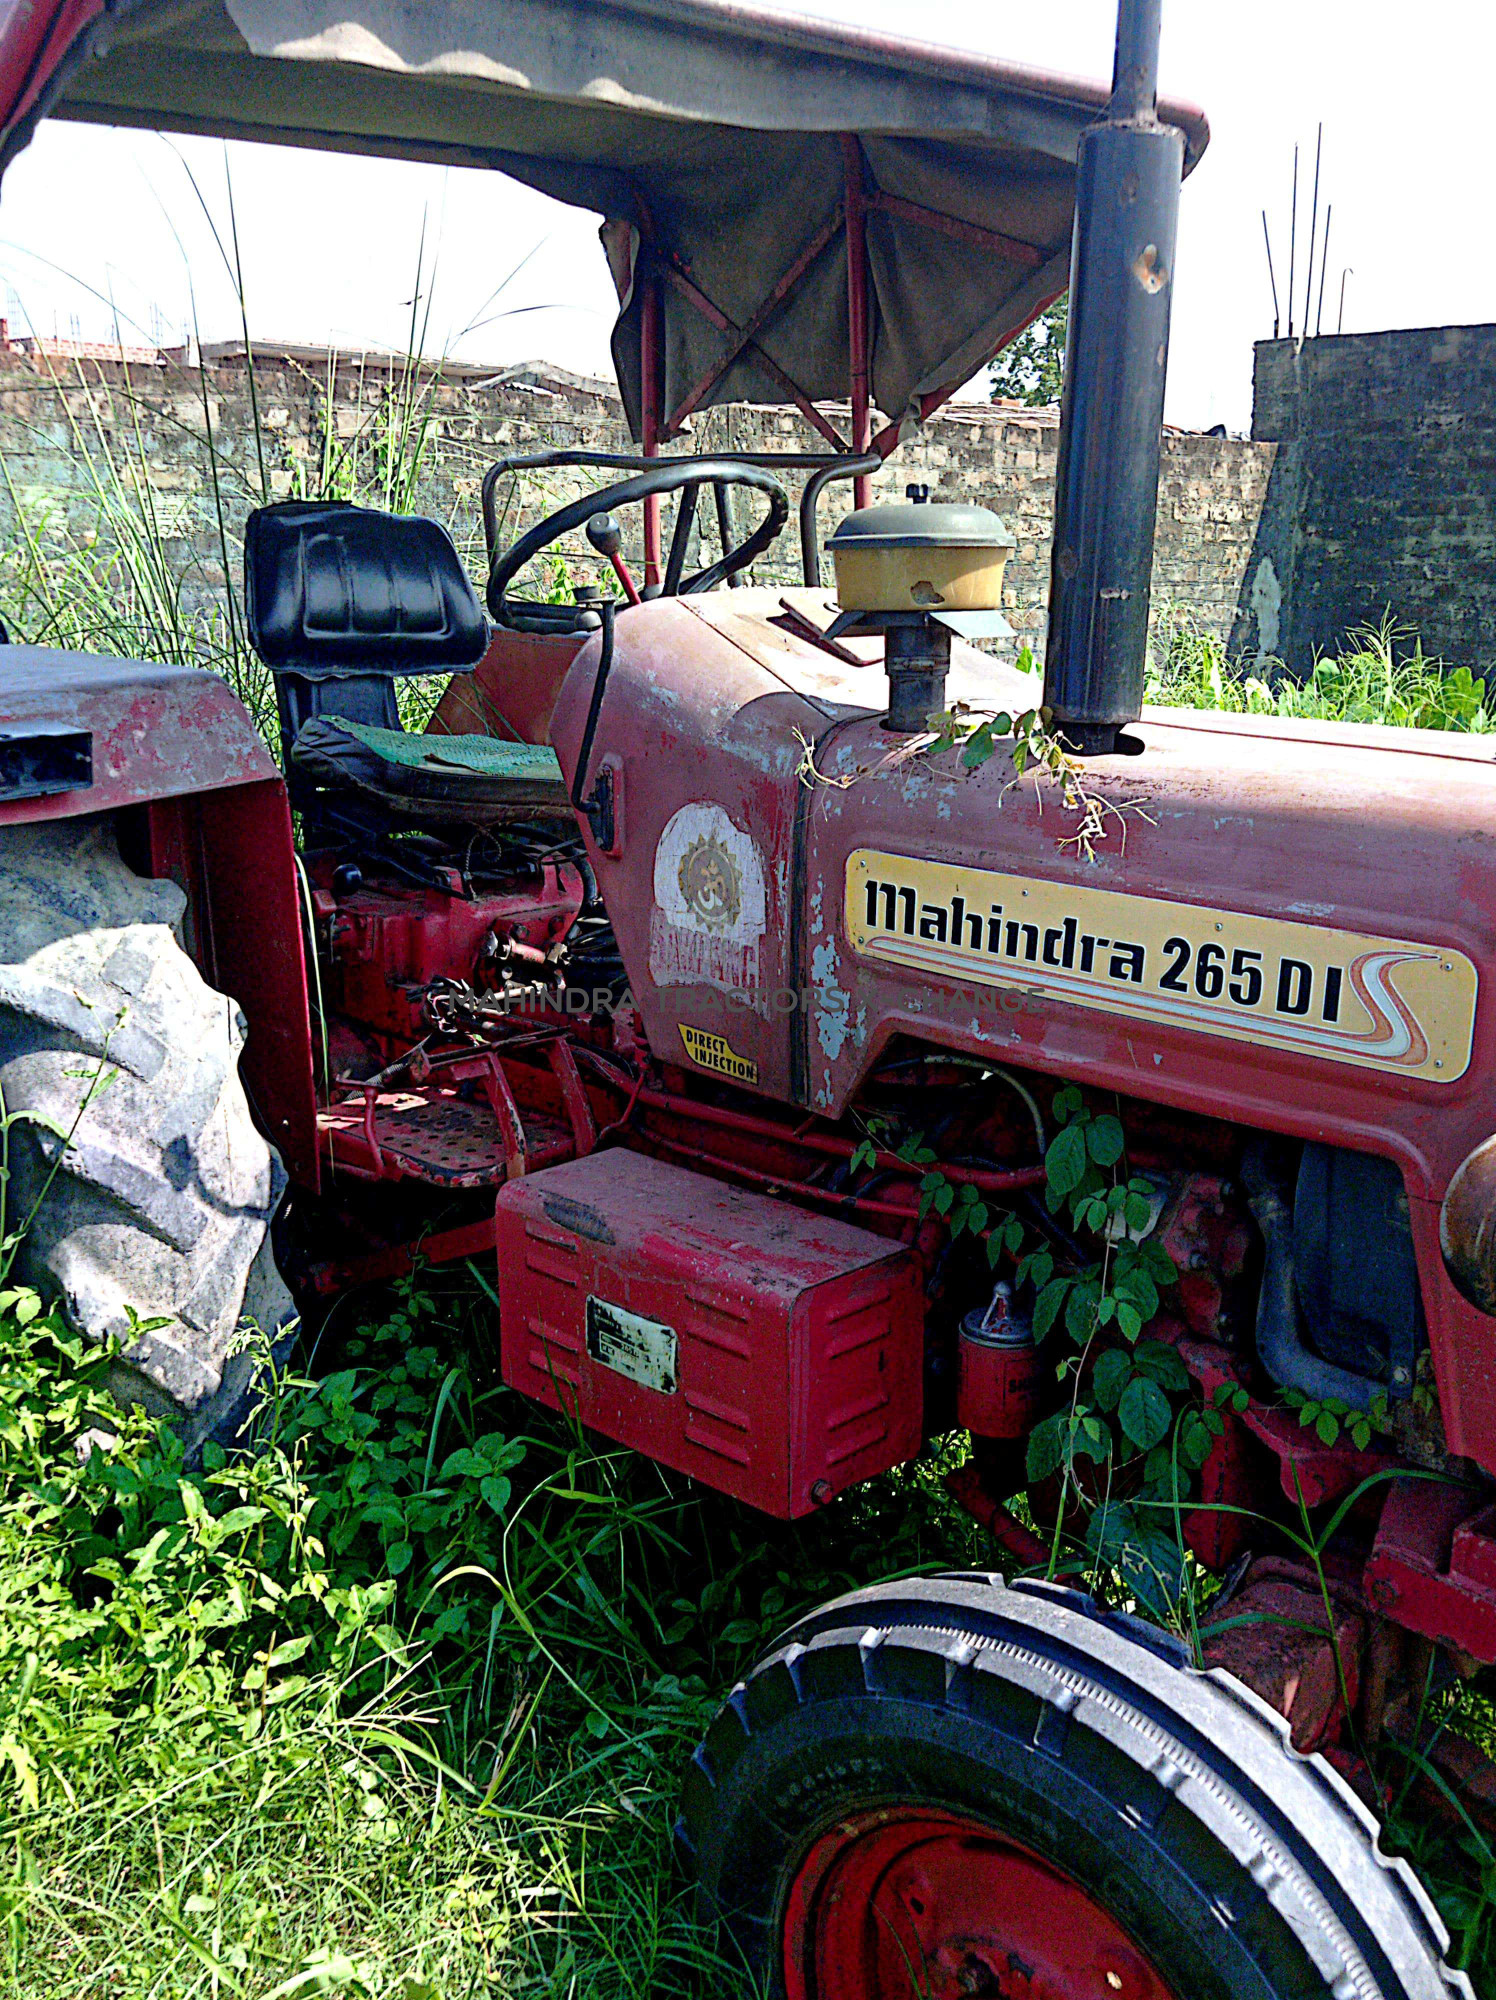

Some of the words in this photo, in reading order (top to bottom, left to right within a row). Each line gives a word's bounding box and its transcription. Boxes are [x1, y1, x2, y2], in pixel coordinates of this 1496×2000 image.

[1159, 936, 1263, 1006] 265
[1275, 957, 1343, 1023] DI
[686, 1029, 725, 1054] DIRECT
[694, 1047, 754, 1080] INJECTION
